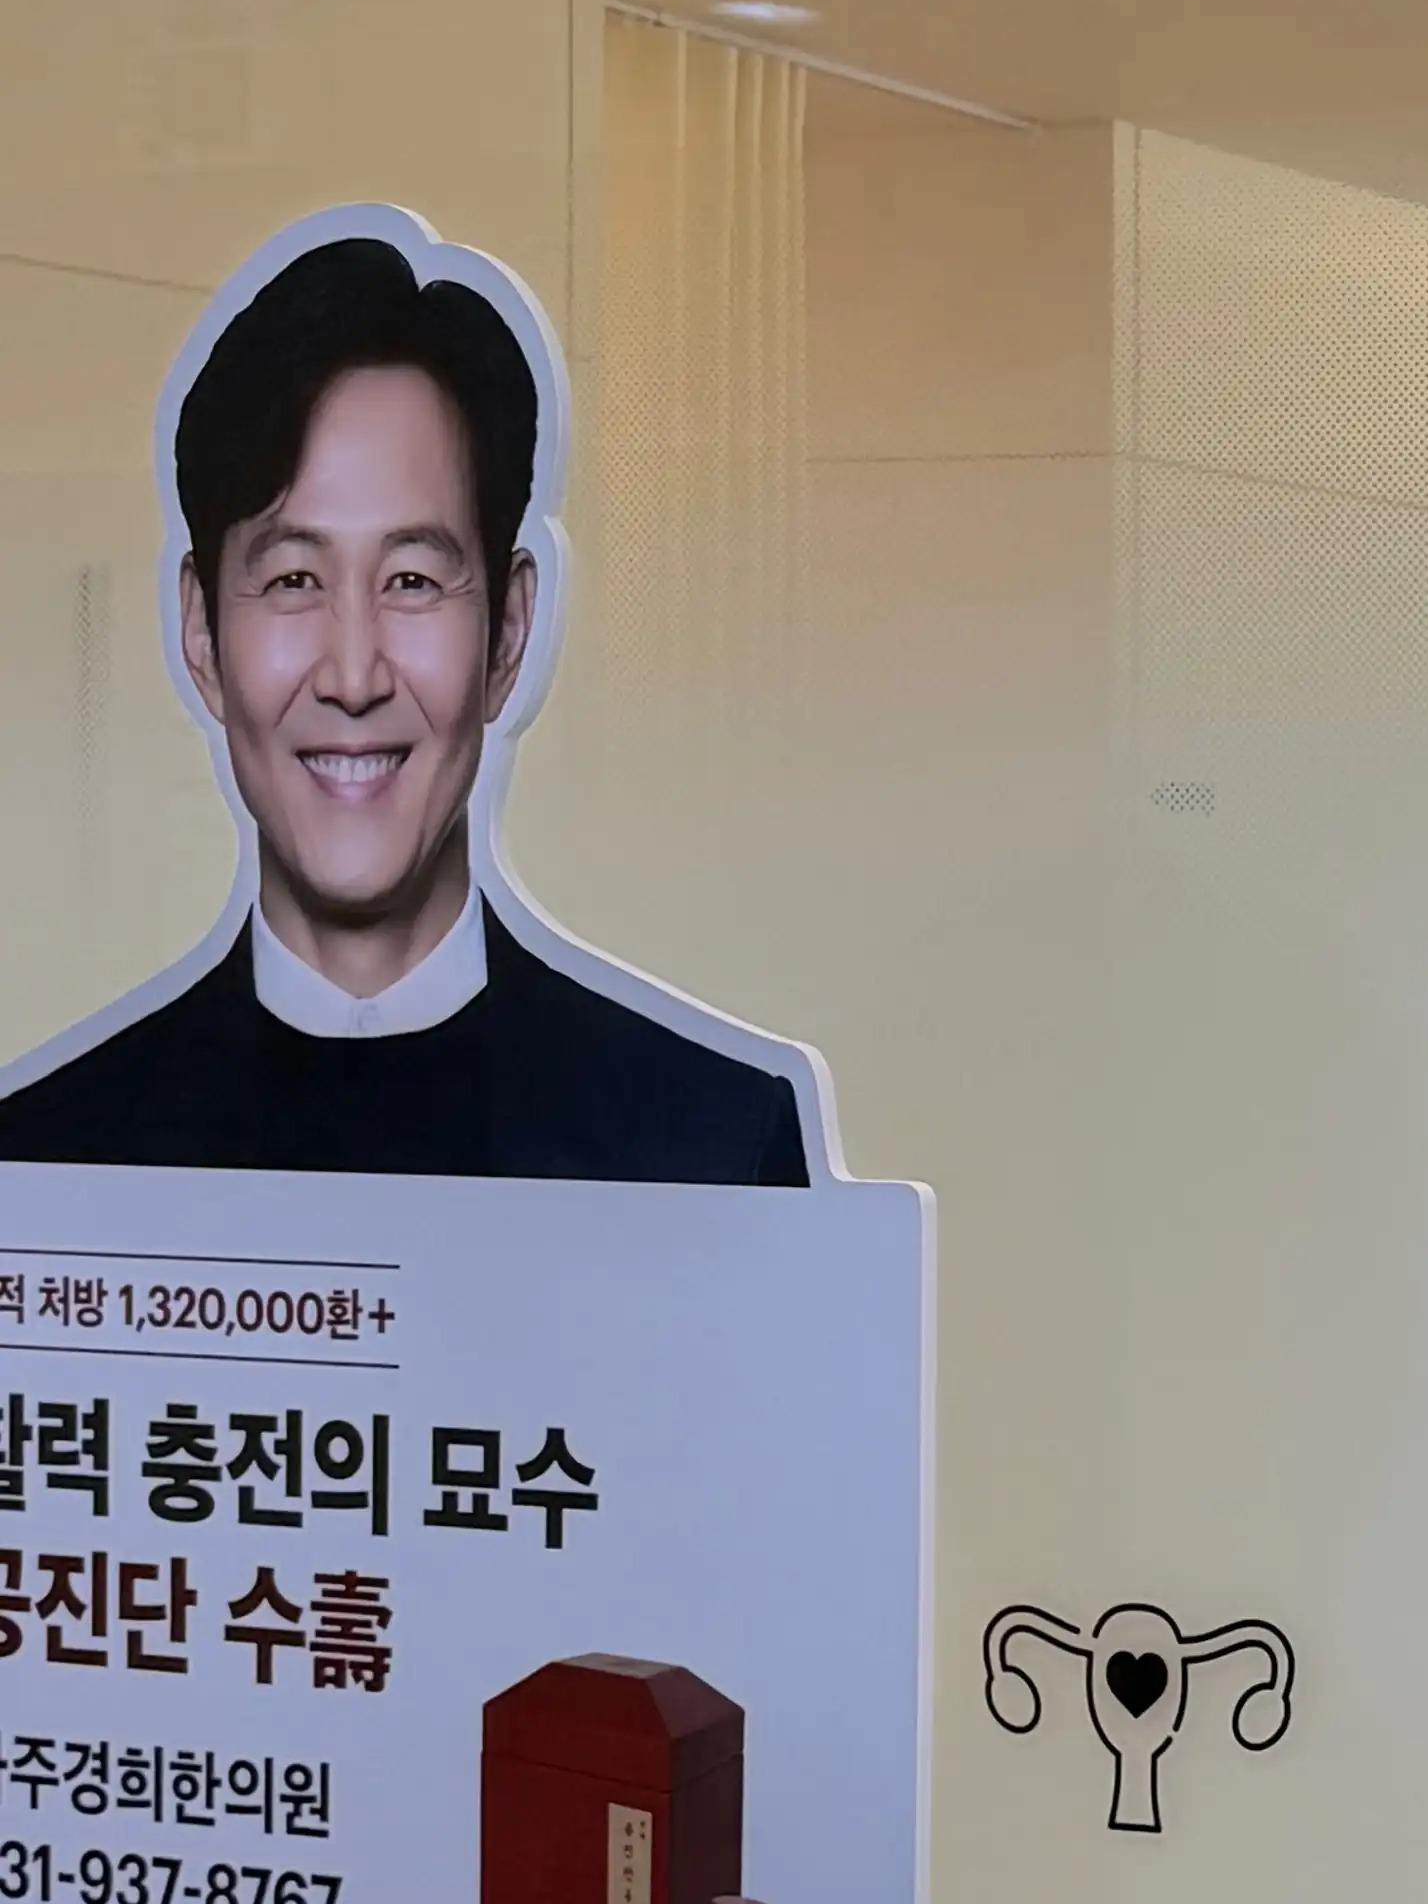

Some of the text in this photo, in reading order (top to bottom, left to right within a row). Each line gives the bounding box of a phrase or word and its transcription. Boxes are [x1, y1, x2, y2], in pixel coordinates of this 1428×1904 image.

[38, 1275, 109, 1328] 처방
[141, 1403, 390, 1537] 충전의
[423, 1426, 599, 1550] 묘수
[0, 1735, 330, 1839] 주경희한의원
